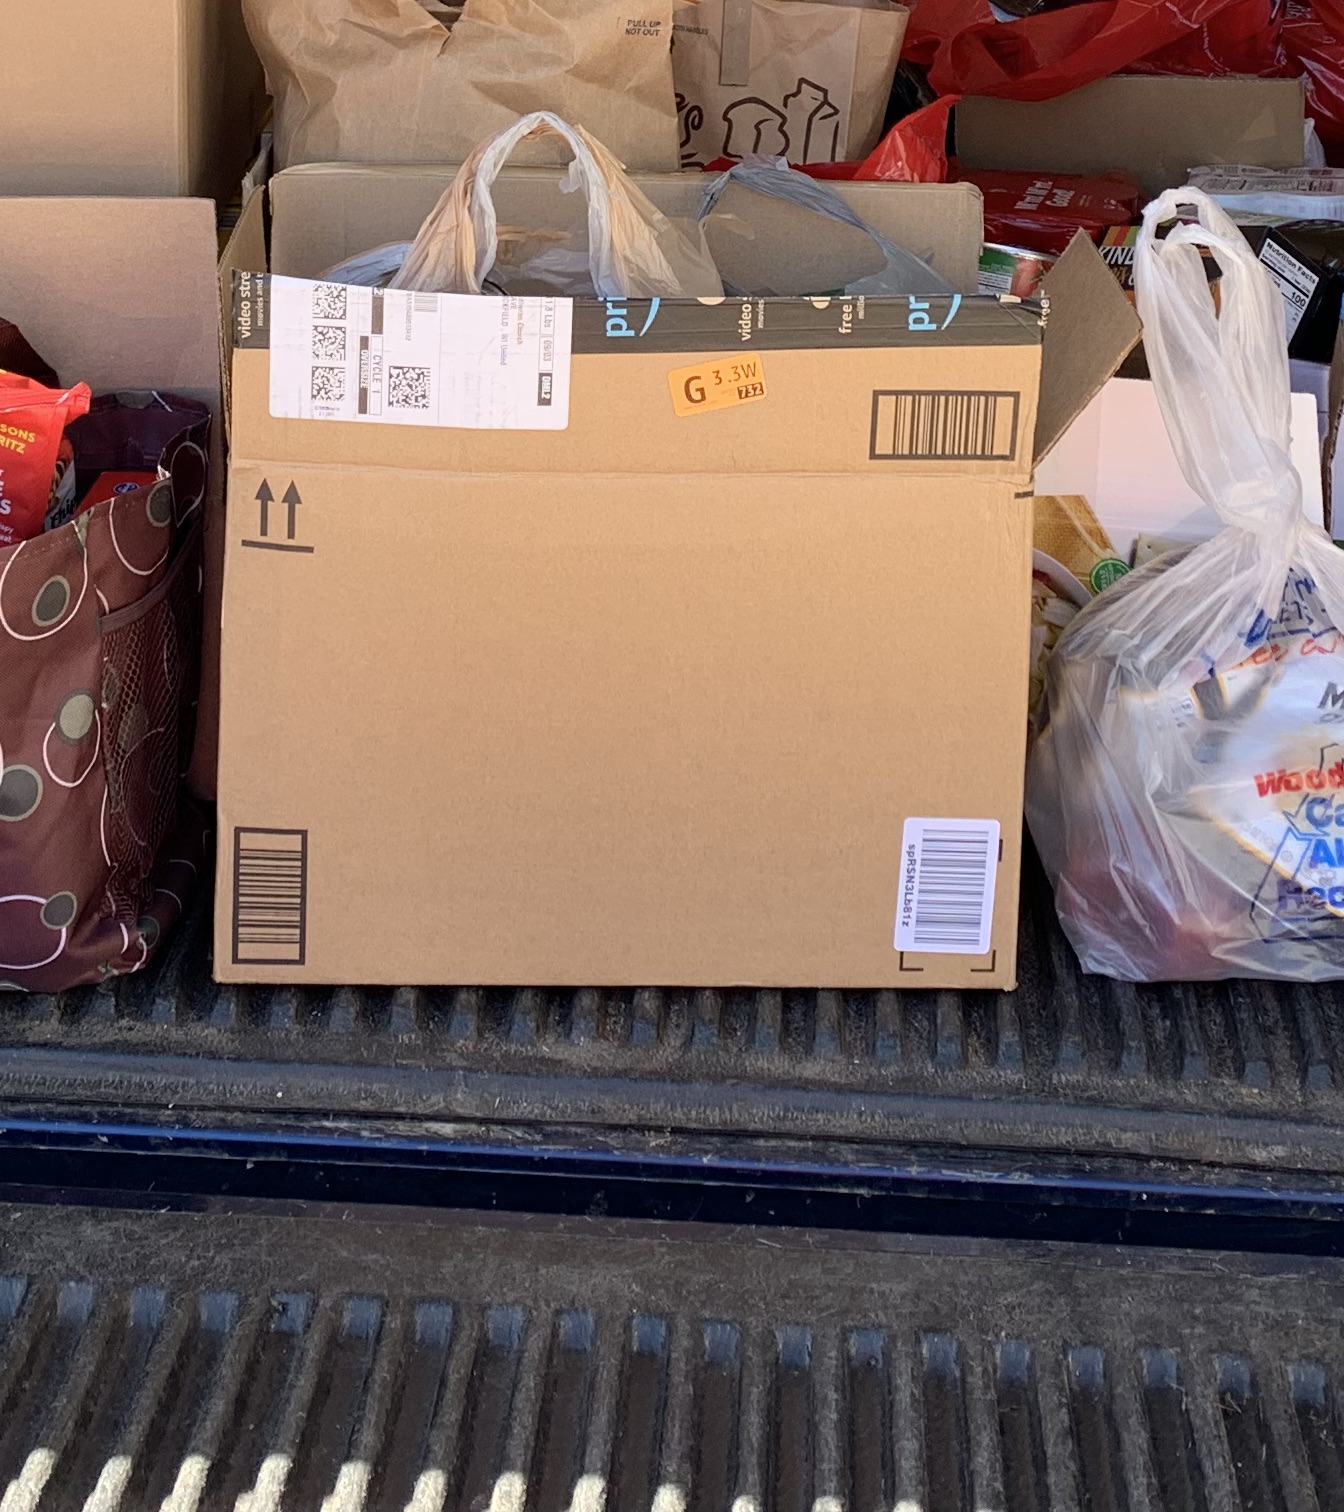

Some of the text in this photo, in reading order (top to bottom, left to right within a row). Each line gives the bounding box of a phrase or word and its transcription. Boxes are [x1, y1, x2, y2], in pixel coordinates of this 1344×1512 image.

[627, 19, 661, 28] PULL UP
[643, 29, 660, 37] OUT
[255, 297, 264, 326] movies
[1291, 291, 1307, 307] 100
[237, 300, 252, 339] video
[598, 296, 635, 337] pri
[735, 303, 753, 341] video
[838, 303, 853, 334] free
[372, 354, 382, 381] CYCLE
[684, 375, 707, 404] G
[738, 383, 763, 399] 732
